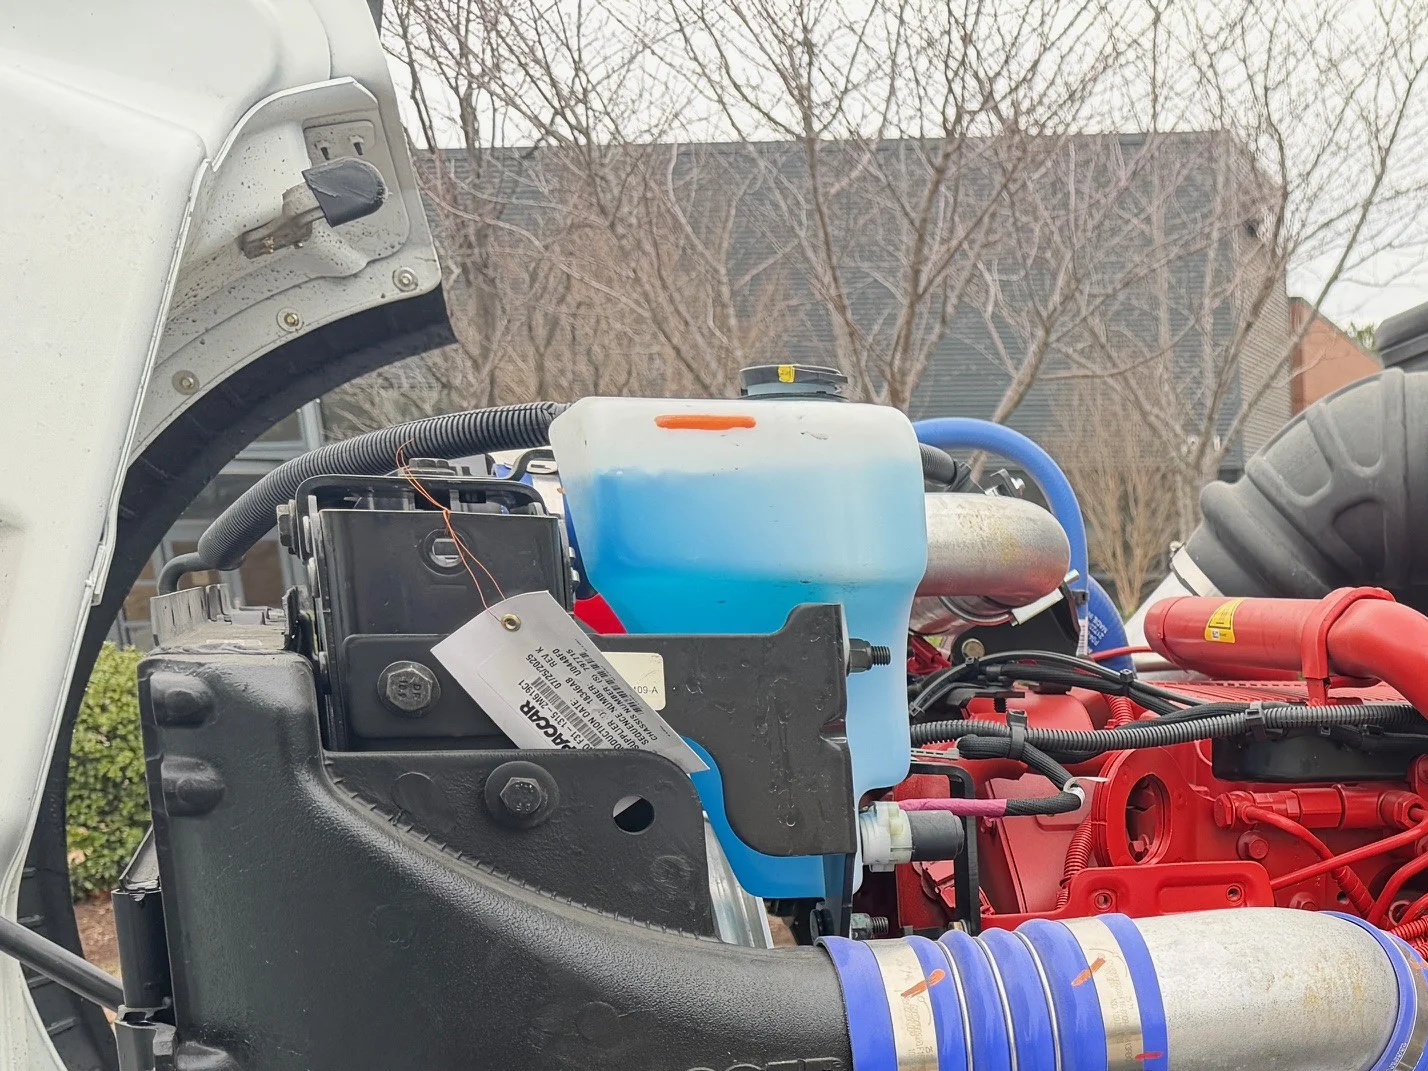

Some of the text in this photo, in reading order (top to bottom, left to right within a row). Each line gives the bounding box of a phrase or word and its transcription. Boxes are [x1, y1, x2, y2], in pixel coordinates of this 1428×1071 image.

[540, 651, 557, 668] REV
[525, 652, 624, 749] ODUCTION DATE: 07/25/2025
[586, 681, 617, 713] NUMBER:
[600, 682, 631, 714] NUMBER:
[519, 699, 577, 749] PACCAR
[606, 718, 639, 749] SUPPLIER
[614, 710, 649, 746] SEQUENCE
[629, 713, 657, 742] CHASSIS
